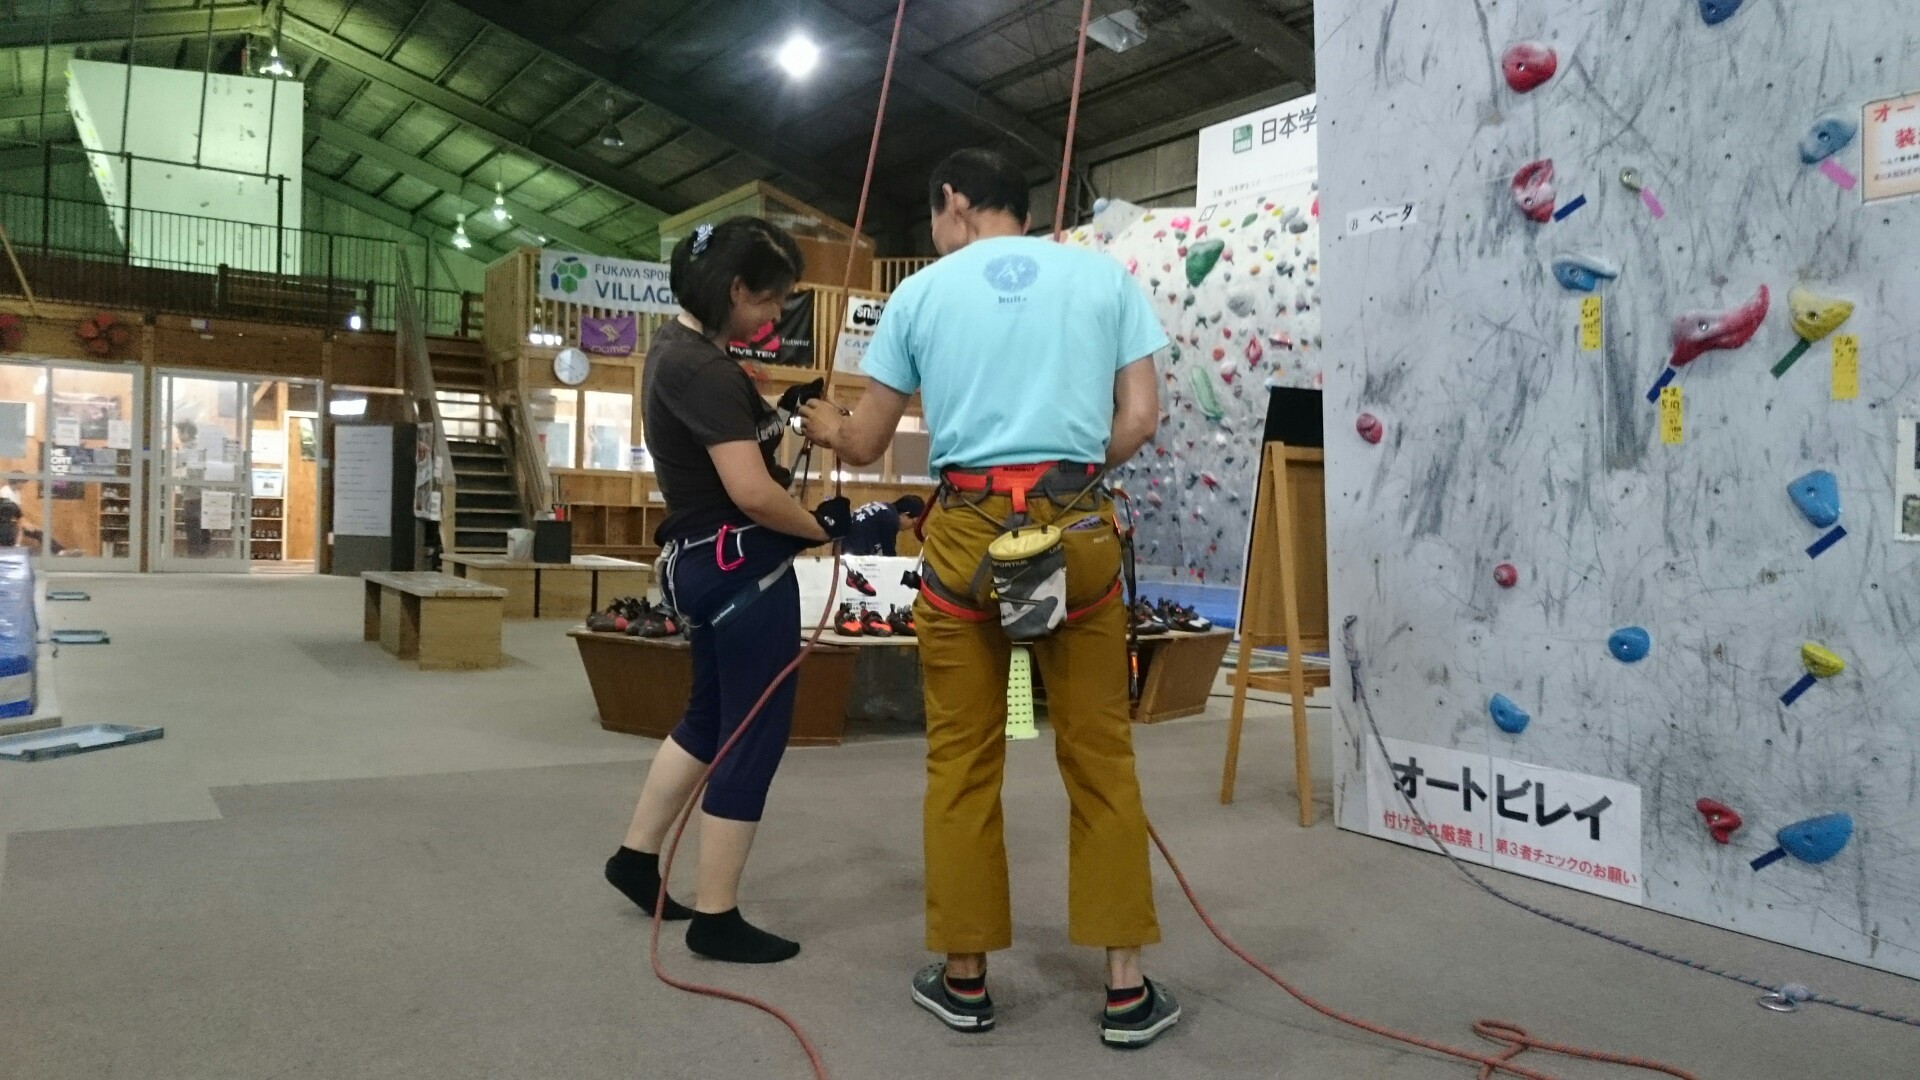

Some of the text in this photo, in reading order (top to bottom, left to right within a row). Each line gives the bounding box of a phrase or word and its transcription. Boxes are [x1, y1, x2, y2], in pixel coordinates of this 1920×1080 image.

[595, 263, 641, 278] FUKAYA
[729, 345, 776, 359] FIVE TEN
[1392, 756, 1613, 841] オートビレイ
